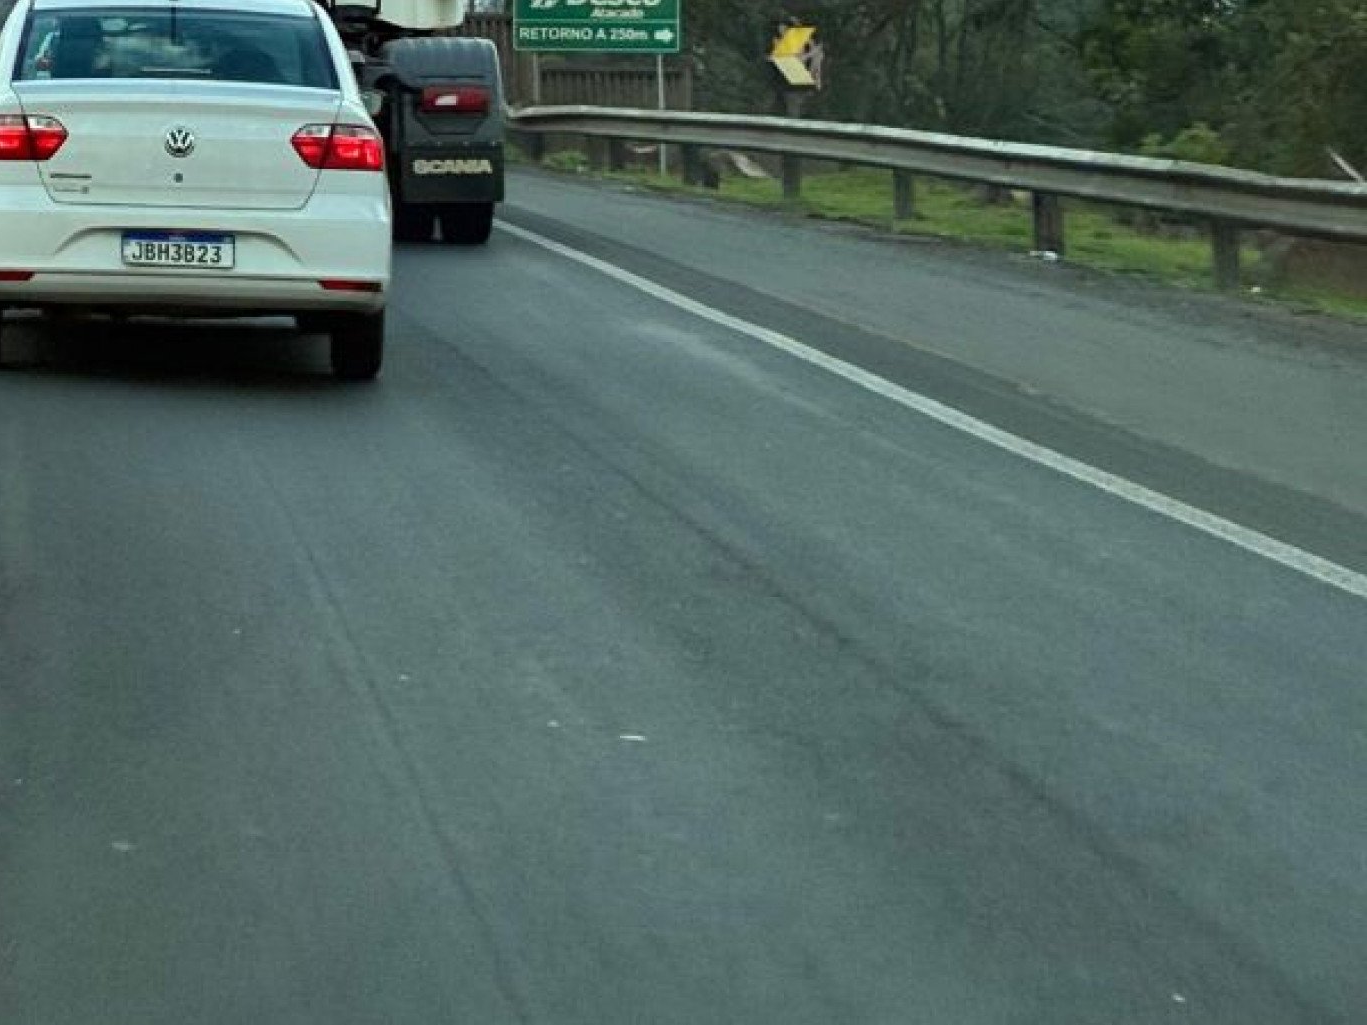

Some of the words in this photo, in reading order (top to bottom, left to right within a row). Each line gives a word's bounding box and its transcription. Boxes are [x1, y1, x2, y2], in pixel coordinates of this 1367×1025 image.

[519, 27, 593, 40] RETORNO
[595, 27, 607, 40] A
[414, 159, 493, 174] SCANIA
[131, 243, 222, 263] JBH3B23
